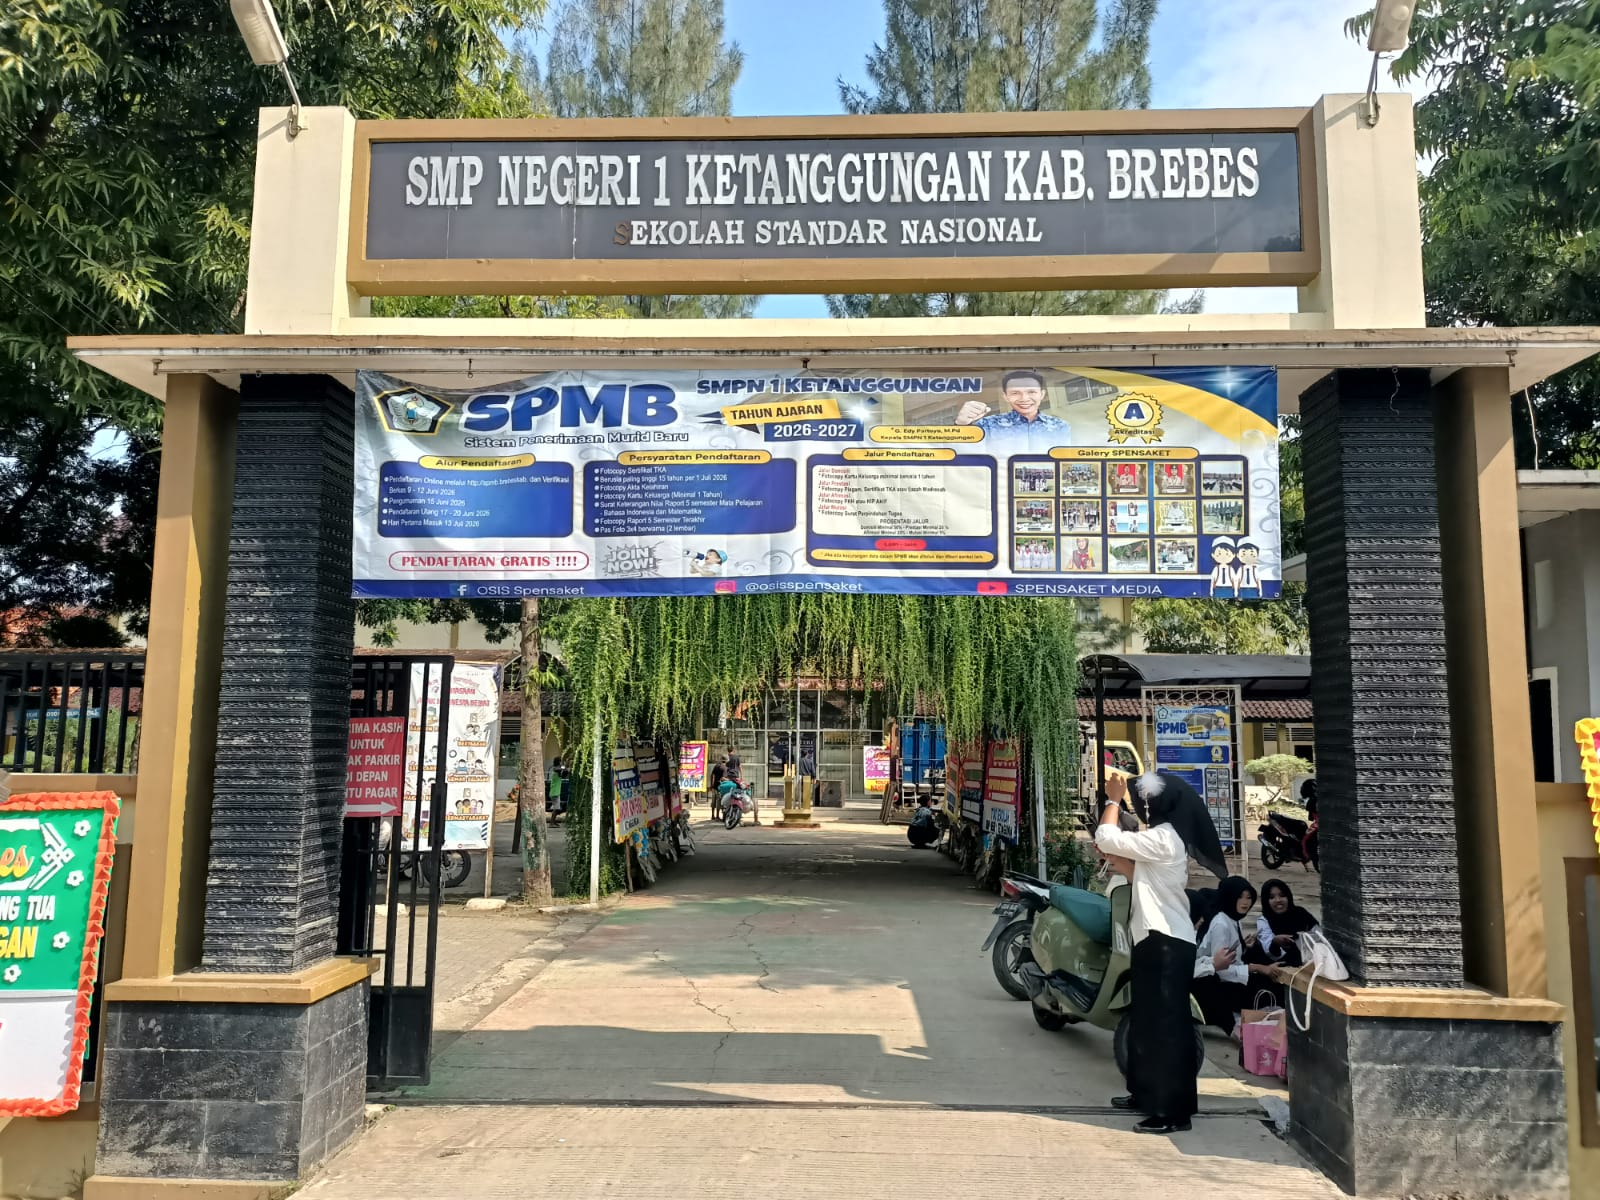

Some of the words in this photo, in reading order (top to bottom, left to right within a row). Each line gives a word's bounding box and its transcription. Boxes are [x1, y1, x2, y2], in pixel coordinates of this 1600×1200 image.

[405, 154, 484, 206] SMP
[496, 154, 641, 206] NEGERI
[653, 155, 671, 207] 1
[687, 151, 992, 205] KETANGGUNGAN
[1003, 148, 1095, 202] KAB.
[1106, 146, 1260, 200] BREBES
[612, 219, 745, 246] SEKOLAH
[755, 218, 888, 245] STANDAR
[900, 216, 1043, 245] NASIONAL
[696, 378, 765, 394] SMPN
[769, 378, 780, 393] 1
[783, 377, 983, 394] KETANGGUNGAN
[463, 383, 679, 432] SPMB
[729, 407, 773, 420] TAHUN
[776, 404, 824, 417] AJARAN
[1123, 402, 1145, 420] A
[773, 424, 857, 438] 2026-2027
[1114, 428, 1155, 436] Akreditasi
[465, 437, 516, 448] Sistem
[519, 434, 604, 446] Penerimaan
[608, 431, 650, 443] Murid
[653, 432, 689, 442] Baru
[629, 454, 692, 462] Persyaratan
[695, 453, 761, 461] Pendaftaran
[1077, 449, 1109, 458] Galery
[1112, 449, 1171, 457] SPENSAKET
[460, 458, 522, 467] Pendaftaran
[599, 467, 626, 475] Fotocopy
[423, 477, 444, 485] Online
[702, 490, 723, 499] Tahun)
[420, 508, 439, 517] Ulang
[599, 518, 626, 526] Fotocopy
[608, 547, 650, 561] JOIN
[401, 556, 496, 567] PENDAFTARAN
[500, 555, 550, 567] GRATIS
[555, 555, 578, 566] !!!!
[607, 557, 657, 573] NOW!
[477, 586, 510, 596] OSIS
[513, 585, 585, 597] Spensaket
[745, 581, 863, 592] @osisspensaket
[1015, 583, 1107, 595] SPENSAKET
[1111, 584, 1162, 595] MEDIA
[349, 722, 370, 734] IMA
[372, 721, 403, 734] KASIH
[1157, 722, 1187, 734] SPMB
[350, 738, 385, 750] UNTUK
[364, 754, 401, 766] PARKIR
[356, 770, 388, 782] DEPAN
[365, 786, 398, 799] PAGAR
[26, 895, 56, 920] TUA
